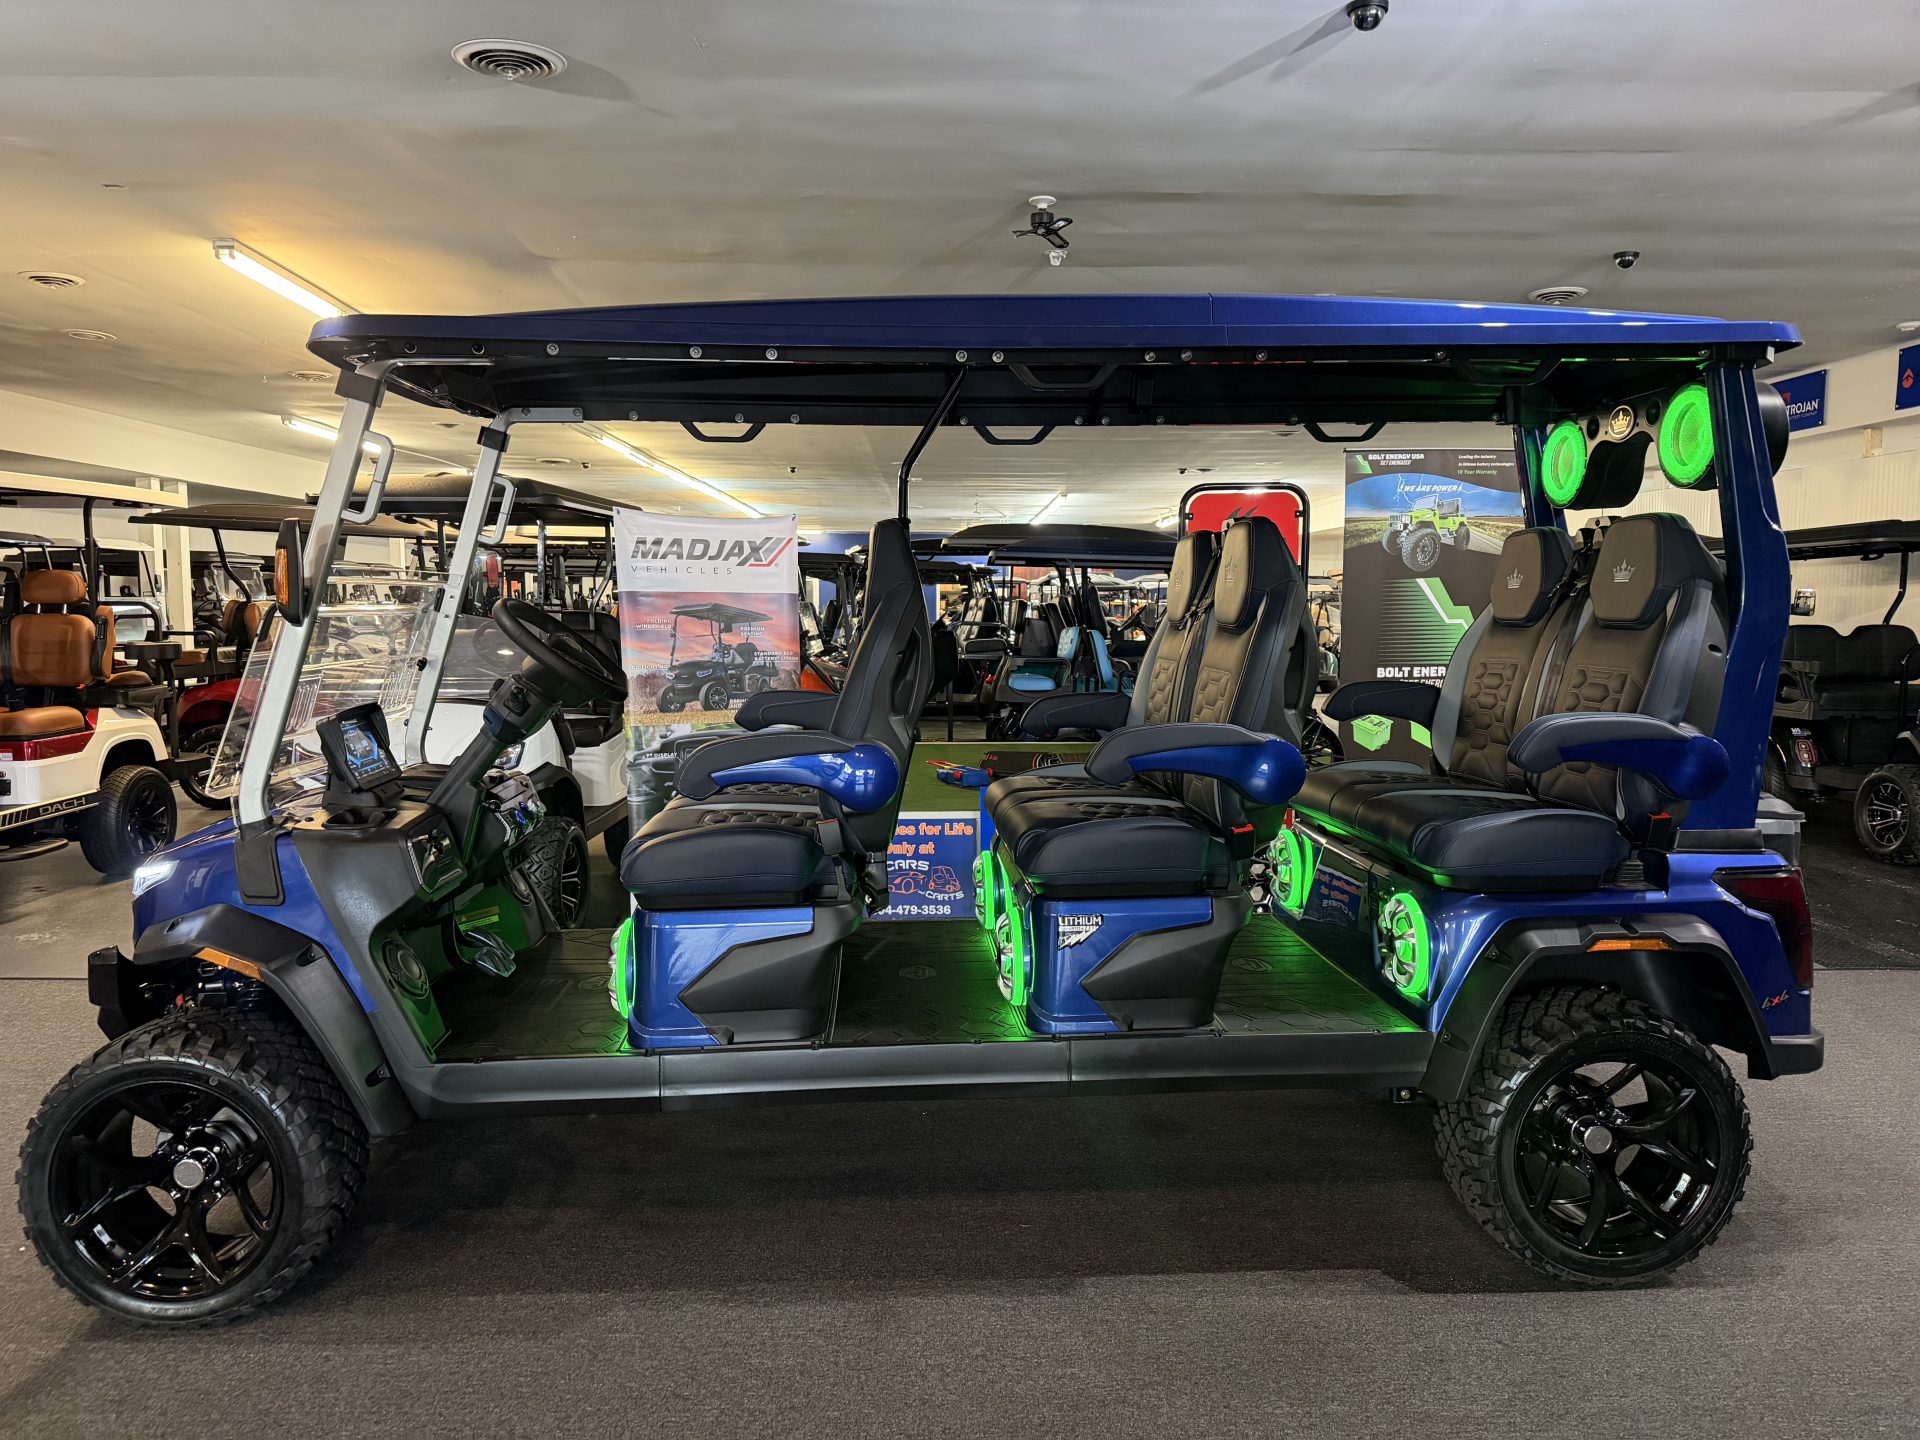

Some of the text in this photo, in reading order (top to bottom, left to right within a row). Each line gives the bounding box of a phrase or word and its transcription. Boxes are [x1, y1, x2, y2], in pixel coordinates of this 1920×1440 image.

[1786, 399, 1819, 415] TROJAN
[631, 537, 775, 567] MADJAX
[631, 565, 733, 575] VEHICLES
[1376, 666, 1411, 678] BOLT
[39, 797, 86, 815] DACH
[919, 822, 941, 836] for
[944, 822, 974, 836] Life
[918, 842, 935, 855] at
[886, 859, 930, 871] CARS
[925, 890, 965, 901] CARTS
[1058, 916, 1102, 926] LITHIUM
